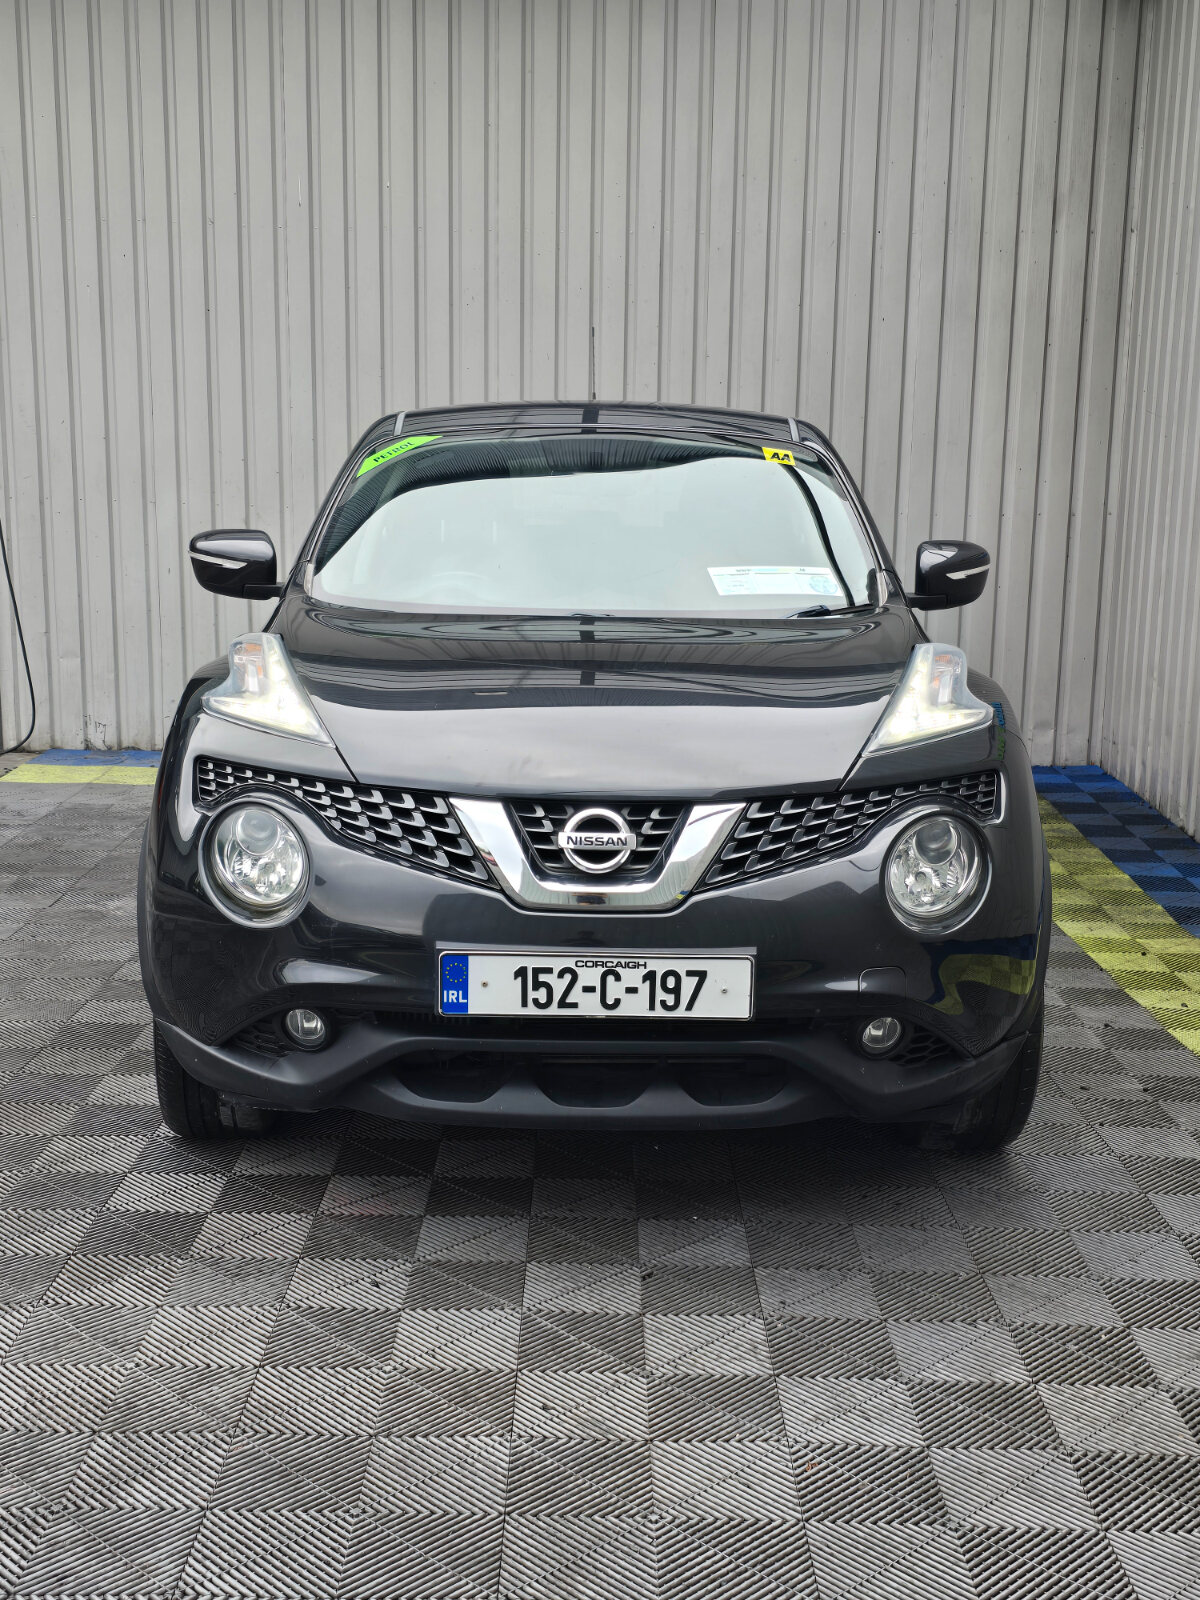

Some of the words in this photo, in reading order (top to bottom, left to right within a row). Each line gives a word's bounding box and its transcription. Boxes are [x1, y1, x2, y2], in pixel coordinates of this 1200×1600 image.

[373, 441, 415, 462] PETROL
[771, 452, 791, 462] AA
[567, 836, 628, 847] NISSAN
[575, 959, 647, 970] CORCAIGH
[513, 965, 708, 1012] 152-C-197
[443, 990, 468, 1003] IRL
